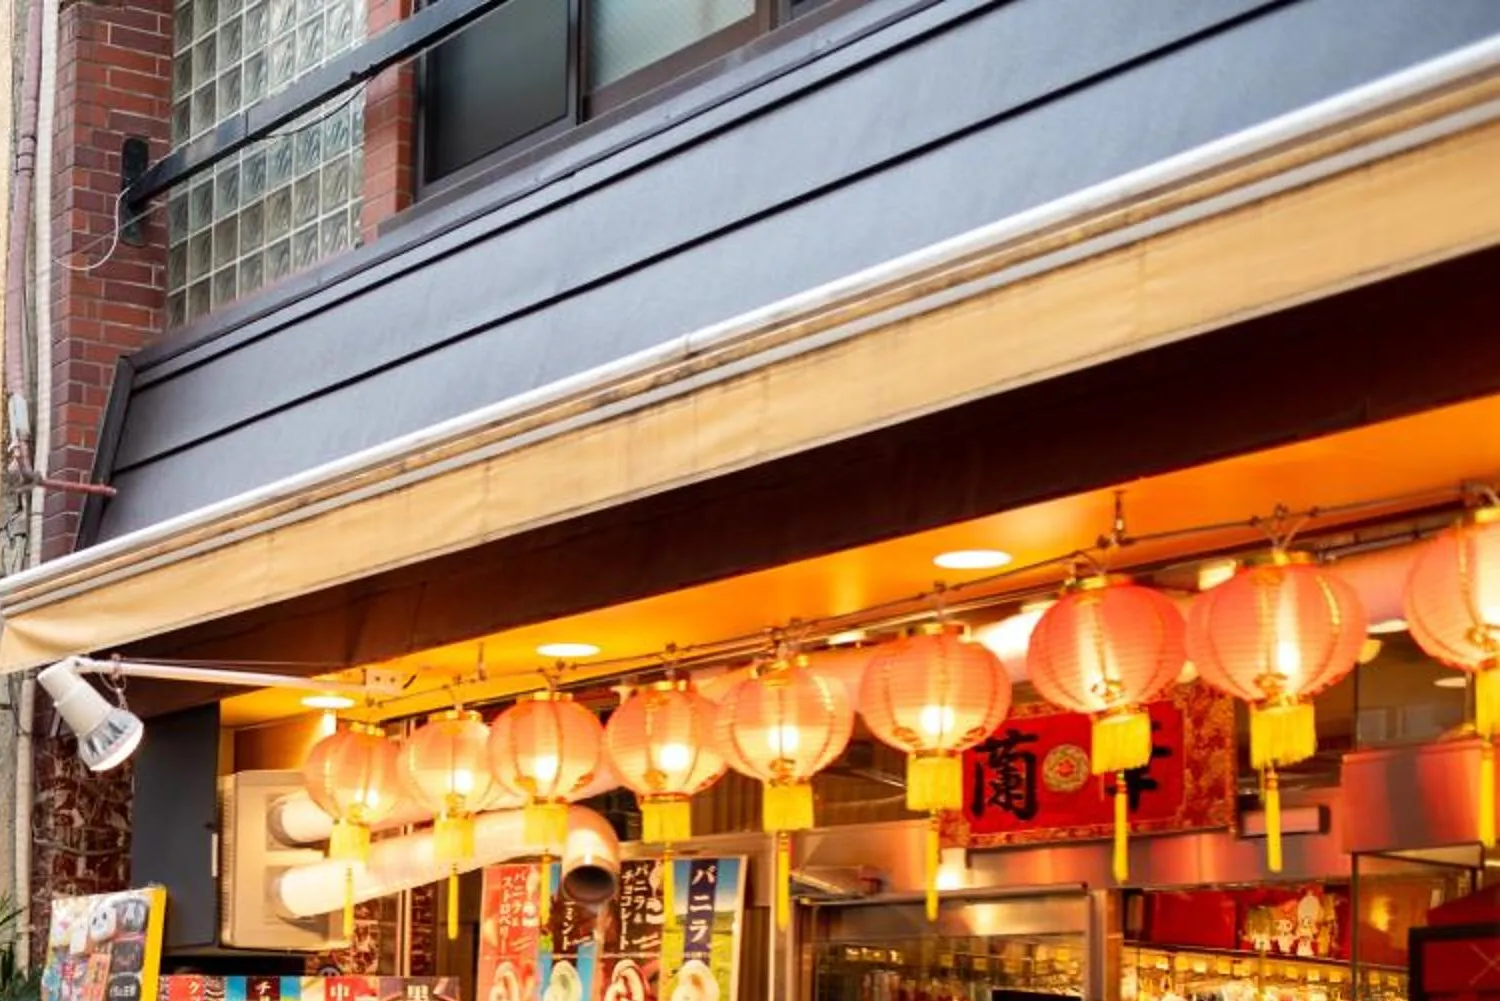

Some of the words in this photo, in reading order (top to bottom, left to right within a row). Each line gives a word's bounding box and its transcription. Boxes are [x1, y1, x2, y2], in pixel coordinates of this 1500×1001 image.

[500, 876, 514, 953] ストロベリー
[620, 872, 635, 950] チョコレート
[689, 865, 715, 937] バニラ
